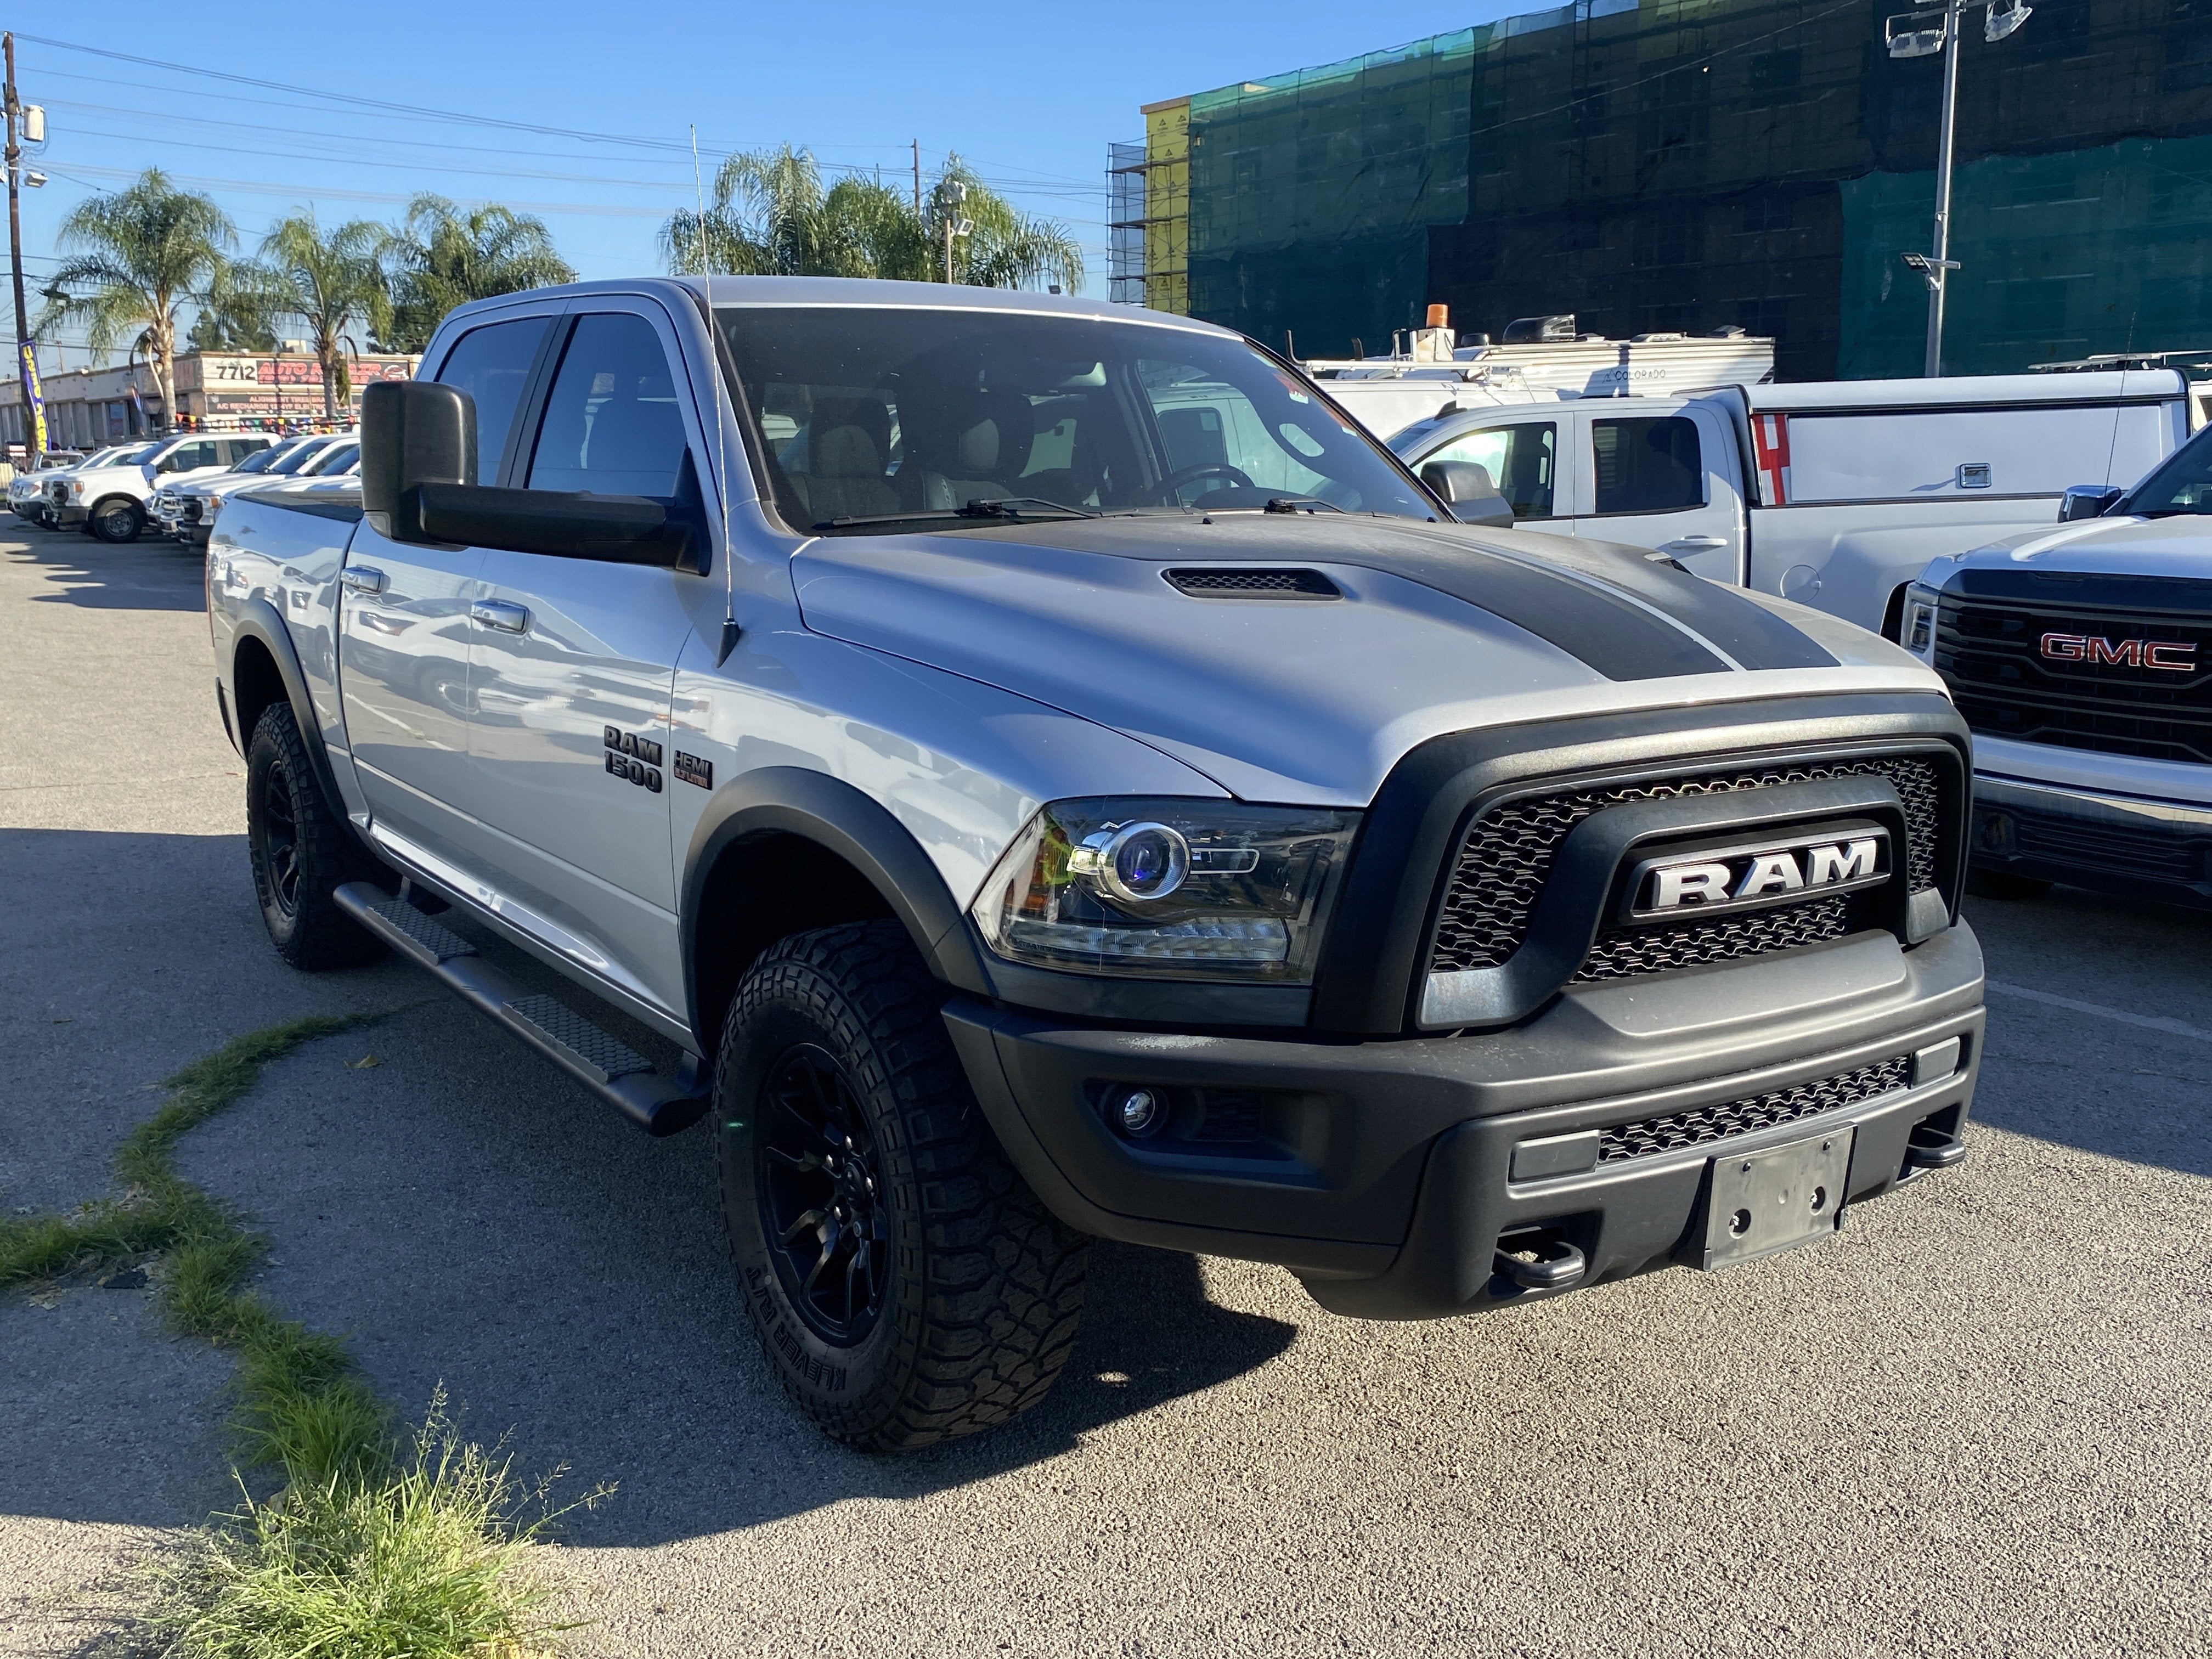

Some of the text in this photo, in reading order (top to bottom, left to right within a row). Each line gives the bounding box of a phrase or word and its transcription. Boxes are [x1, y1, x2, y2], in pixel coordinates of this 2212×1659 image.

[216, 366, 255, 380] 7712
[258, 362, 381, 376] AUTO RAIR
[1615, 369, 1666, 380] COLORADO
[23, 346, 47, 453] USED CARS
[2041, 633, 2197, 671] GMC
[604, 725, 662, 767] RAM
[674, 750, 709, 776] HEMI
[604, 751, 662, 793] 1500
[1655, 839, 1877, 907] RAM
[774, 1322, 847, 1391] KLEVER
